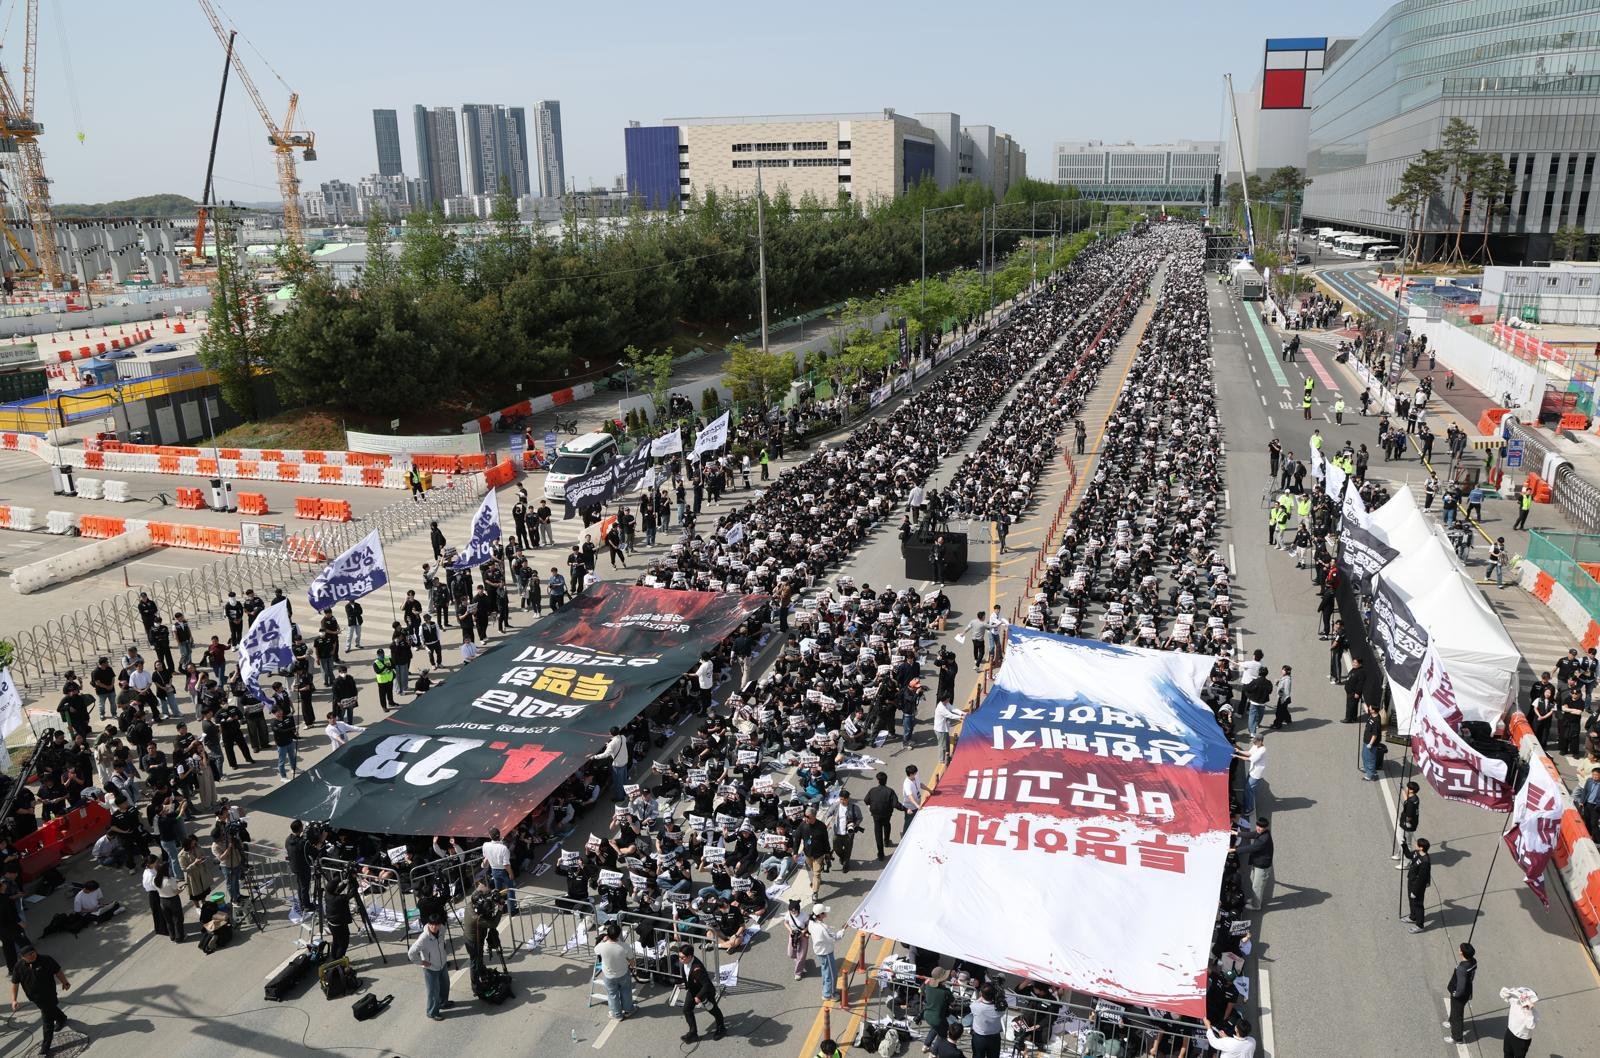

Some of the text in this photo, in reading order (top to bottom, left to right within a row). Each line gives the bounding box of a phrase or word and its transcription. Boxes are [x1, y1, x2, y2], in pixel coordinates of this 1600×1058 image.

[471, 689, 591, 719] 성과급
[497, 666, 615, 701] 투명화
[355, 733, 564, 786] 4.23
[991, 724, 1197, 767] 상한폐지
[963, 768, 1176, 817] 바꾸고!!!
[949, 813, 1189, 874] 투명하게
